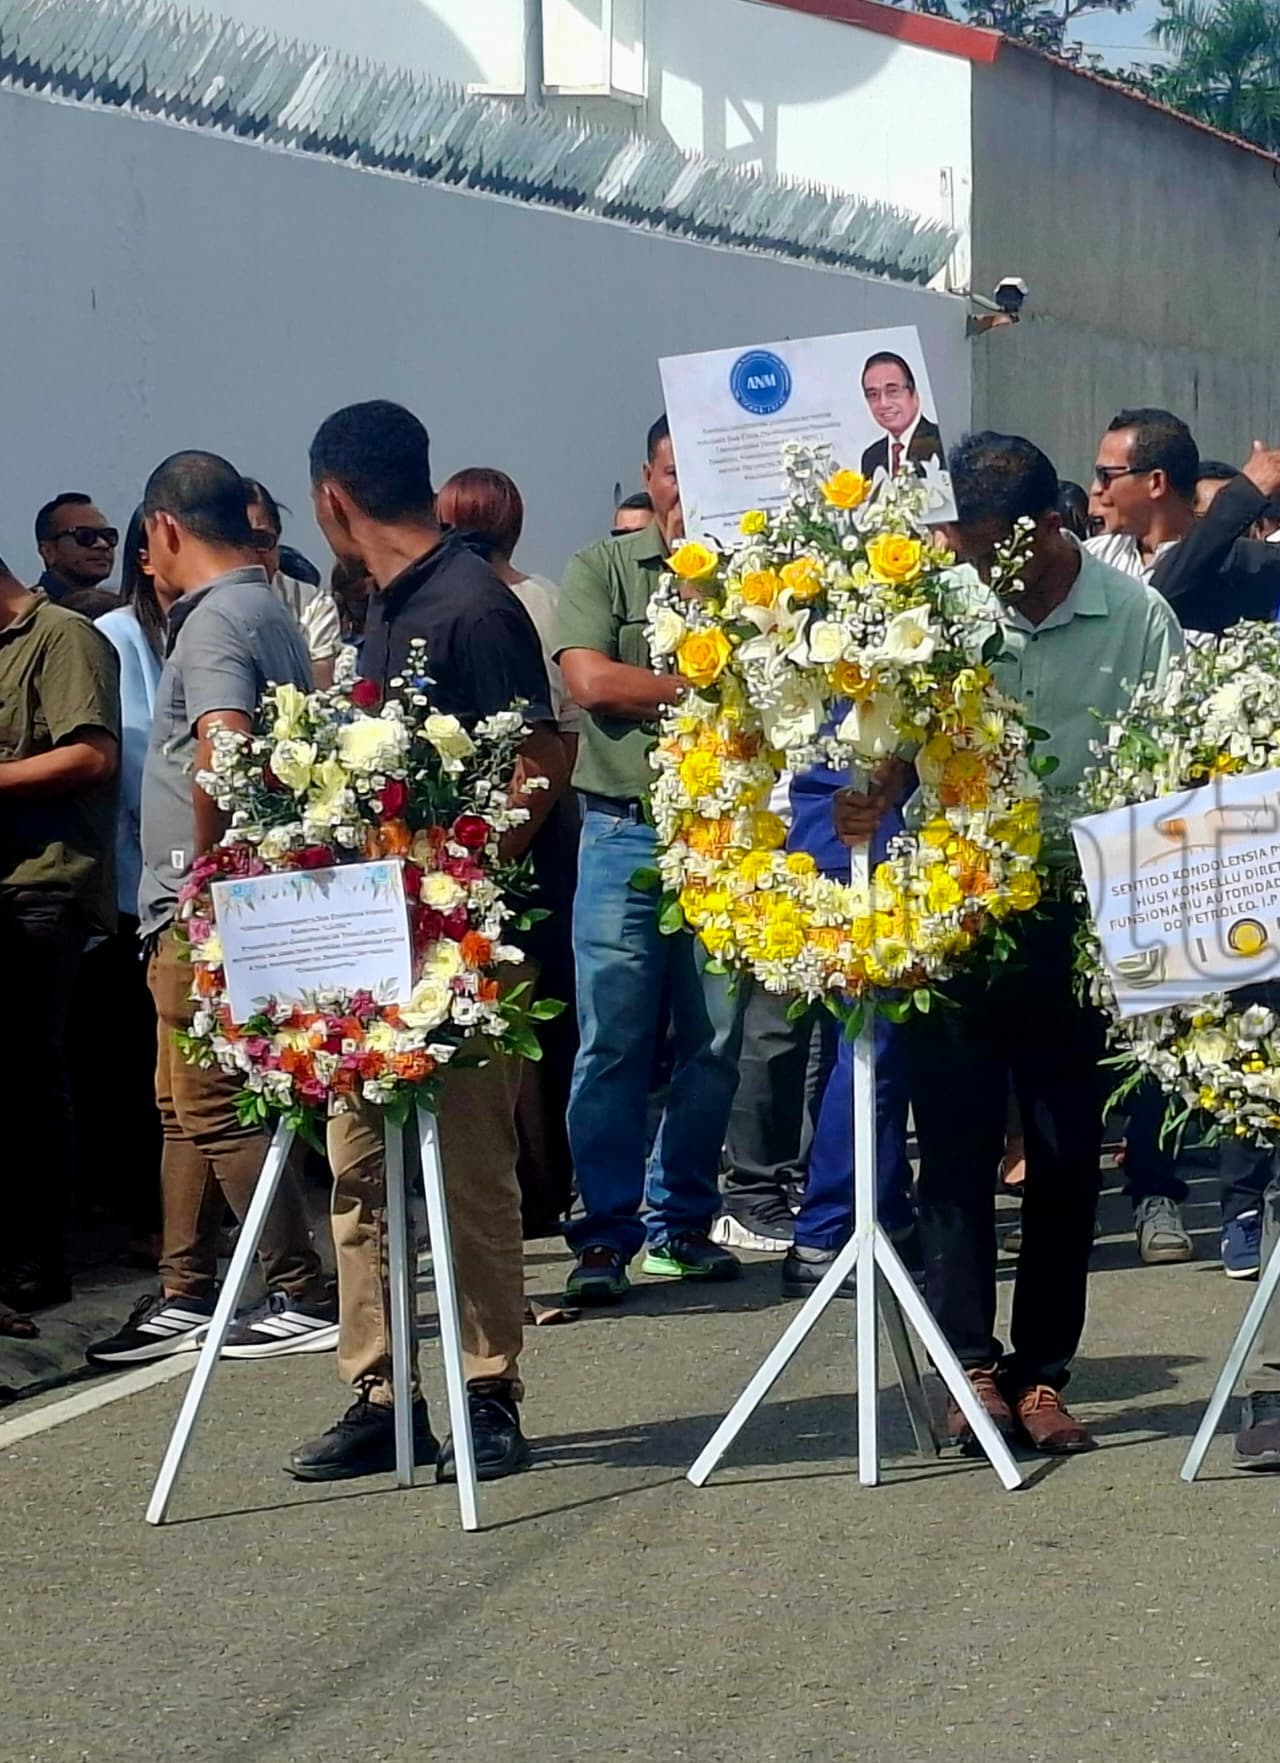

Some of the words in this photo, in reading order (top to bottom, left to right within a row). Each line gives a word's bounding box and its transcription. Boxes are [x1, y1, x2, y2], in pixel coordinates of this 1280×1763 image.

[1111, 873, 1169, 897] SENTIDO
[1172, 847, 1267, 880] KONDOLENSIA
[1135, 890, 1169, 909] HUSI
[1172, 871, 1241, 898] KONSELLU
[1109, 898, 1202, 932] FUNSIONARIU
[1163, 919, 1184, 933] DO
